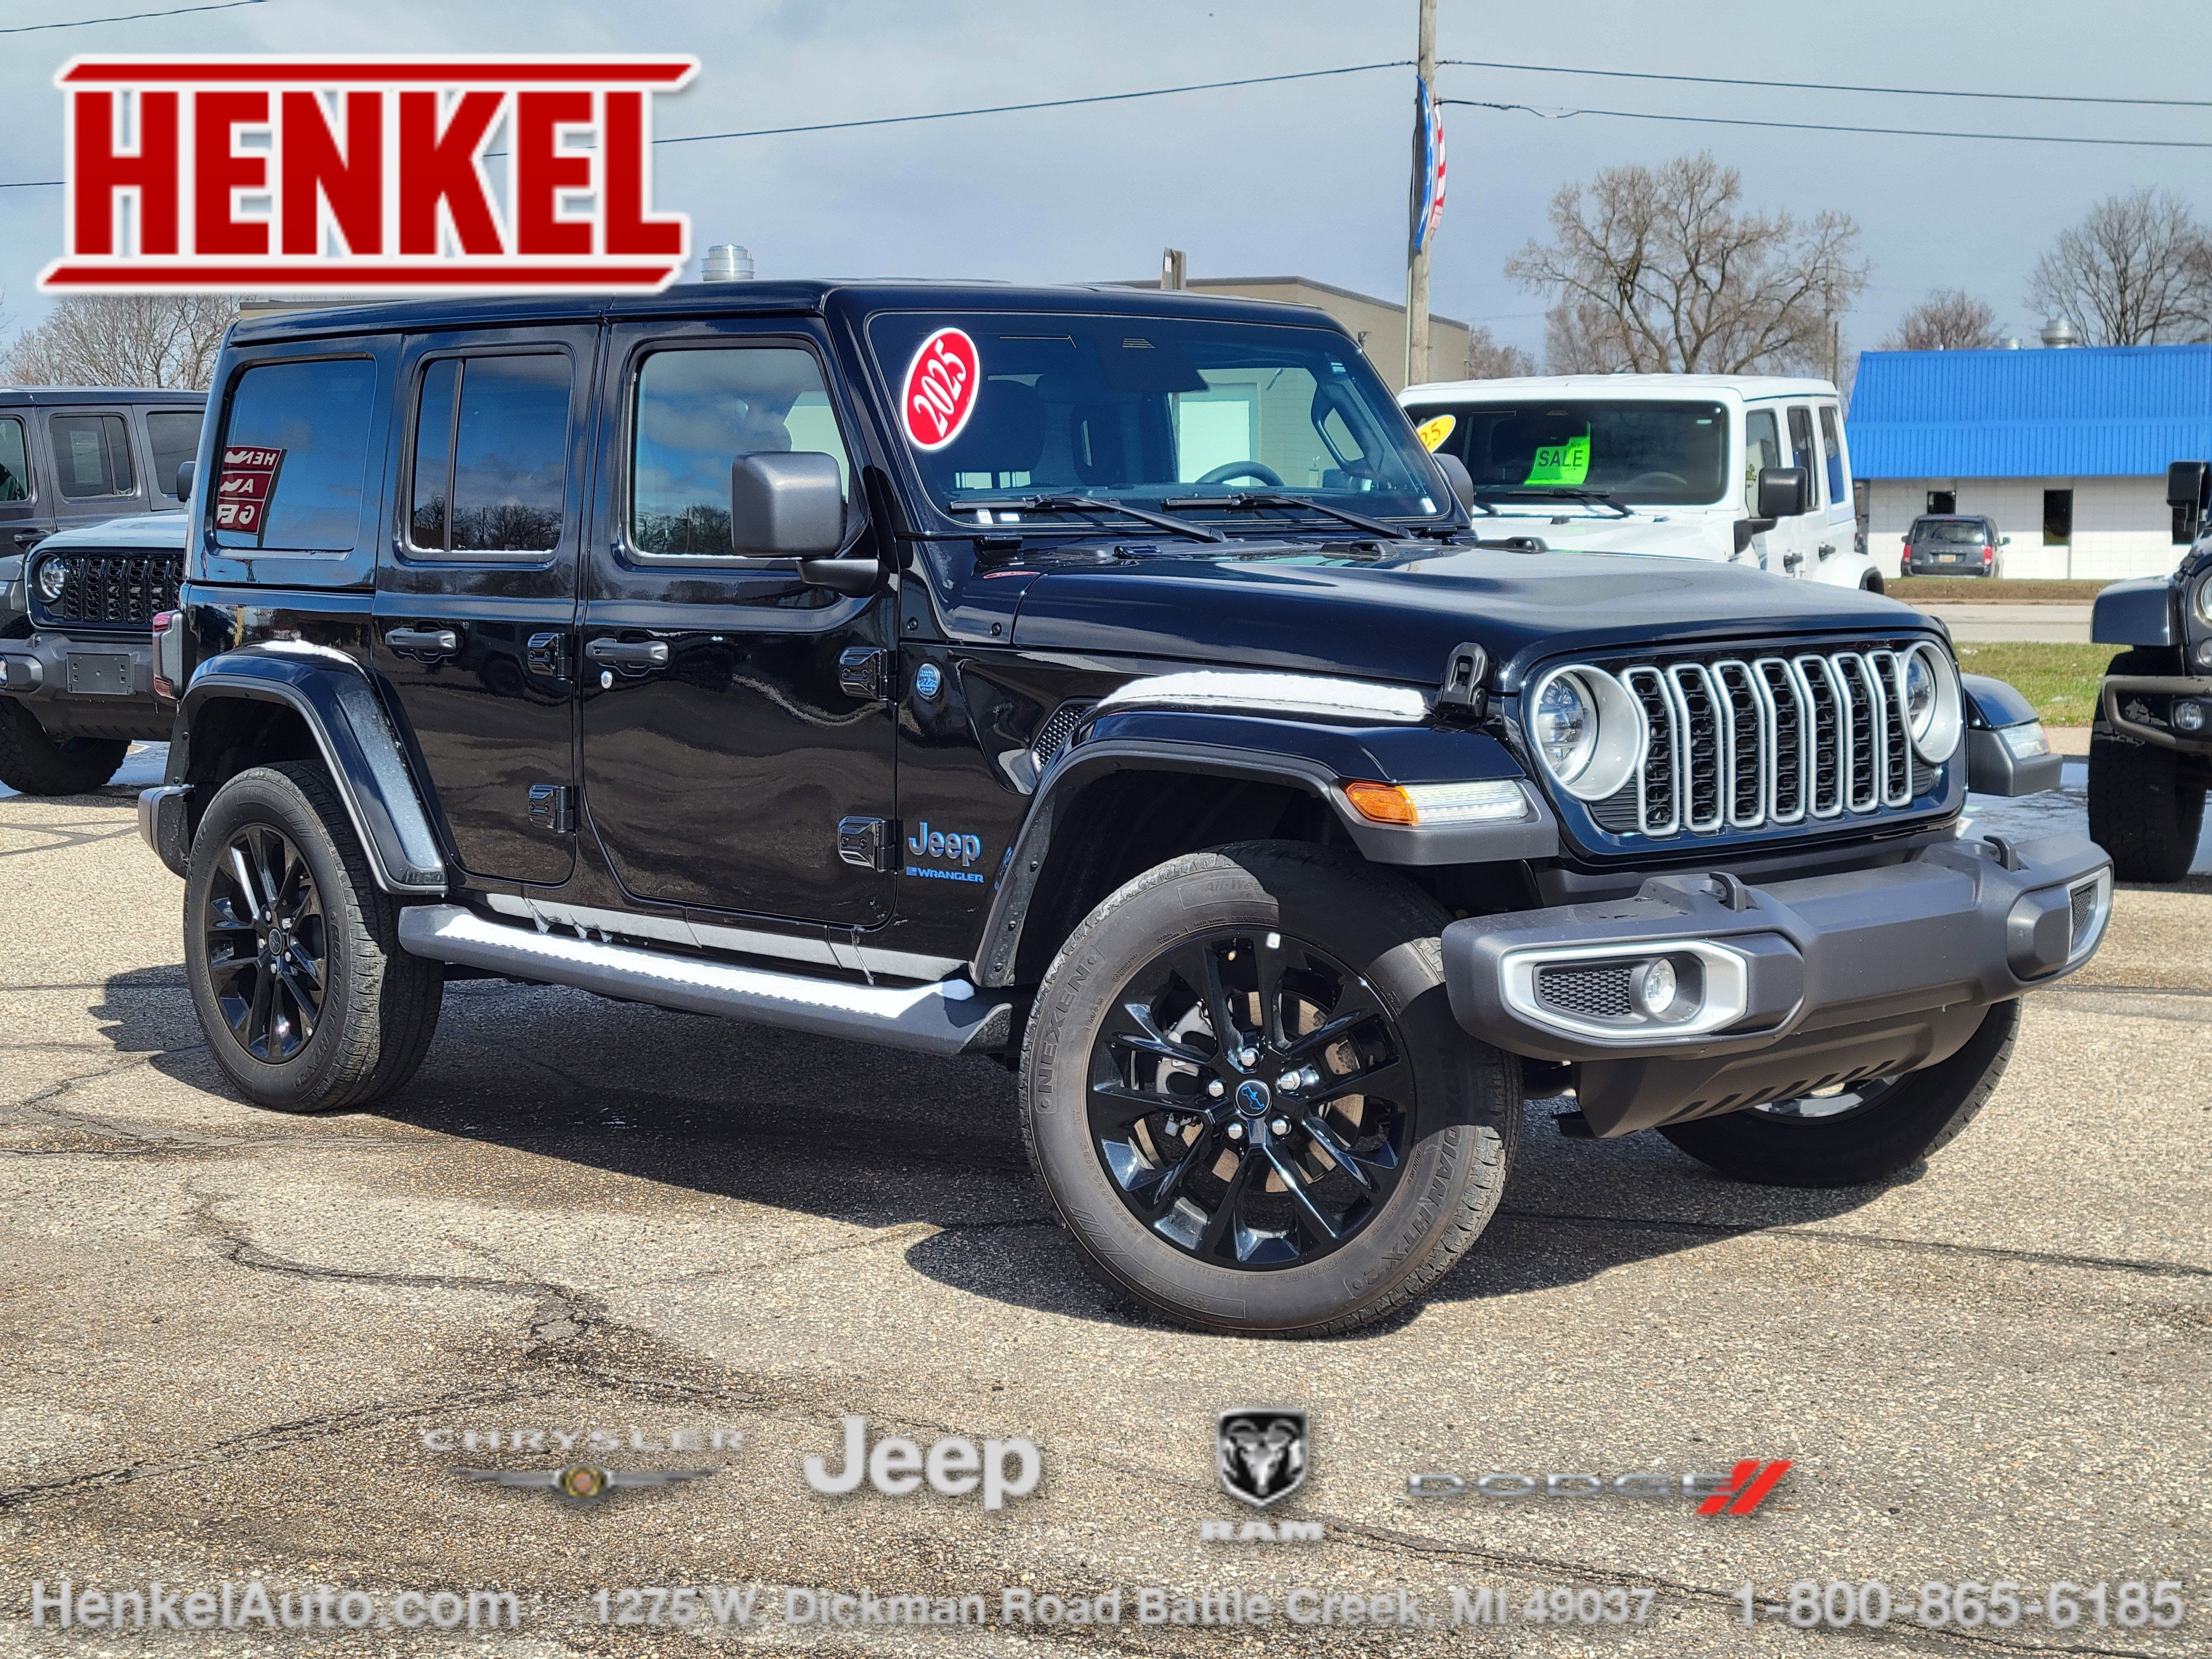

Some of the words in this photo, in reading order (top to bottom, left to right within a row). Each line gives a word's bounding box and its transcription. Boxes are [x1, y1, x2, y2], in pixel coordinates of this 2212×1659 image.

[913, 338, 967, 438] 2025
[1420, 421, 1441, 447] 25
[1538, 450, 1584, 467] SALE
[908, 821, 981, 867] Jeep
[917, 867, 984, 883] WRANGLER
[1038, 963, 1092, 1094] NEXEN
